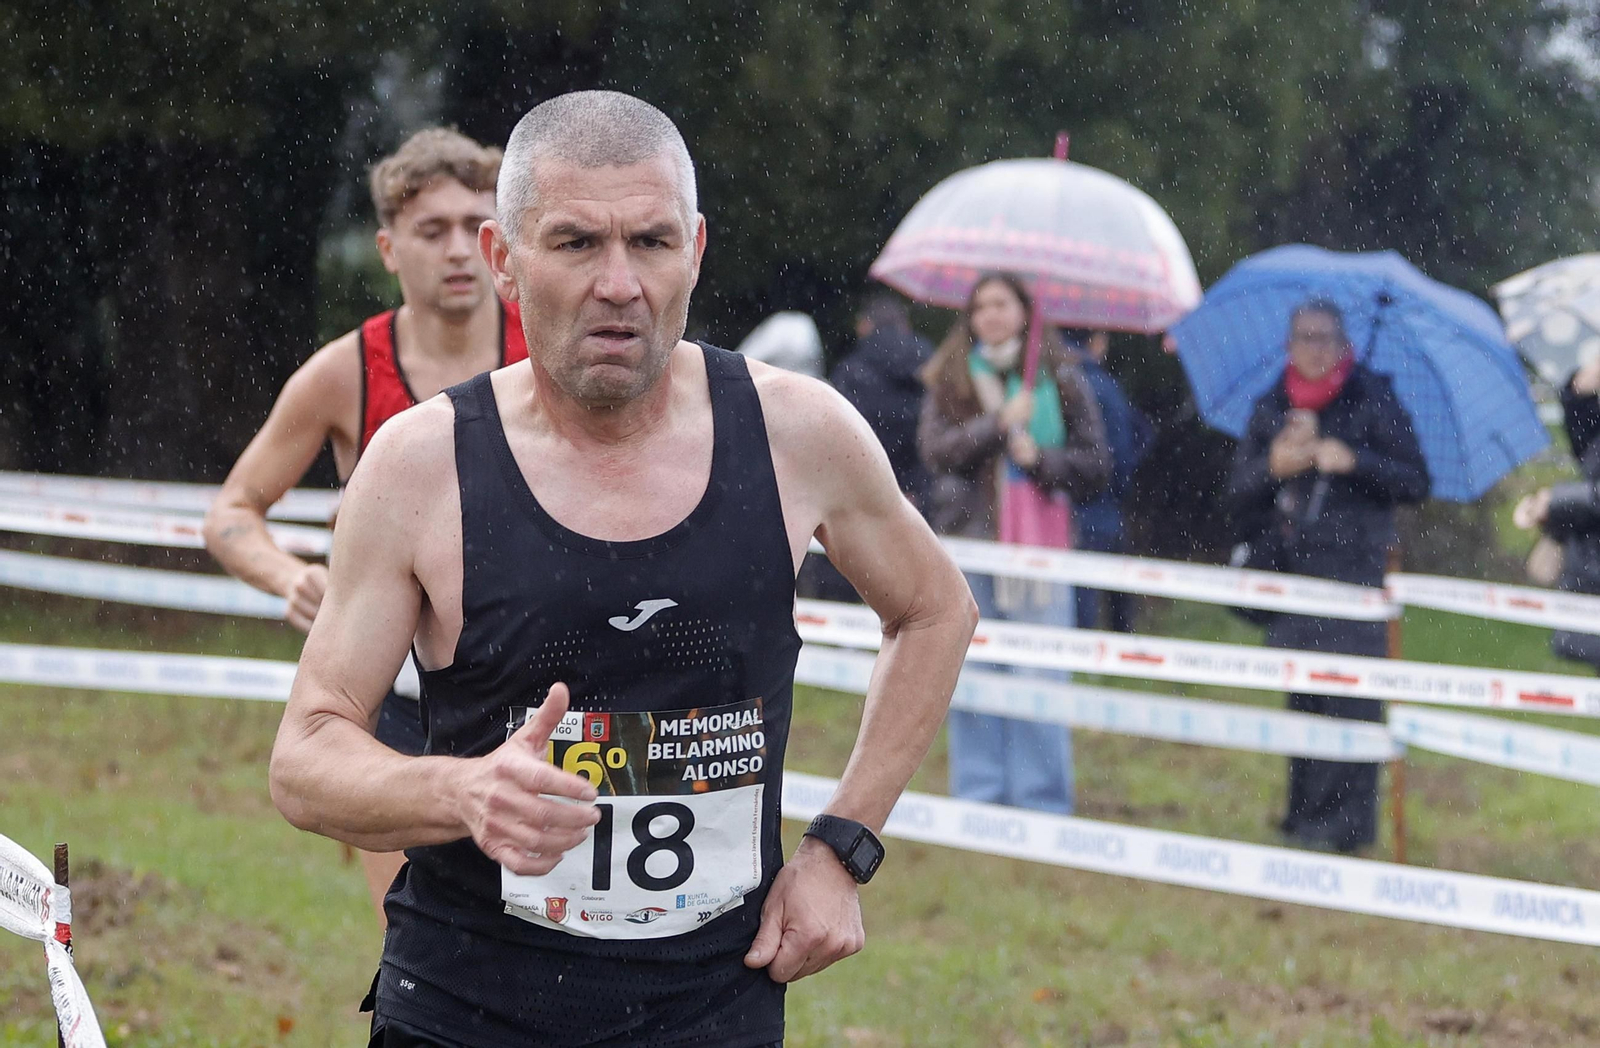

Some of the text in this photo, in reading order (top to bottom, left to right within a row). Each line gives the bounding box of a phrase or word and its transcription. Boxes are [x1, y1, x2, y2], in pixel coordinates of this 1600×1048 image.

[555, 726, 572, 735] IGO
[660, 708, 763, 737] MEMORIAL
[647, 731, 765, 760] BELARMINO
[681, 755, 763, 781] ALONSO
[592, 802, 695, 891] 18
[697, 898, 721, 906] GALICIA
